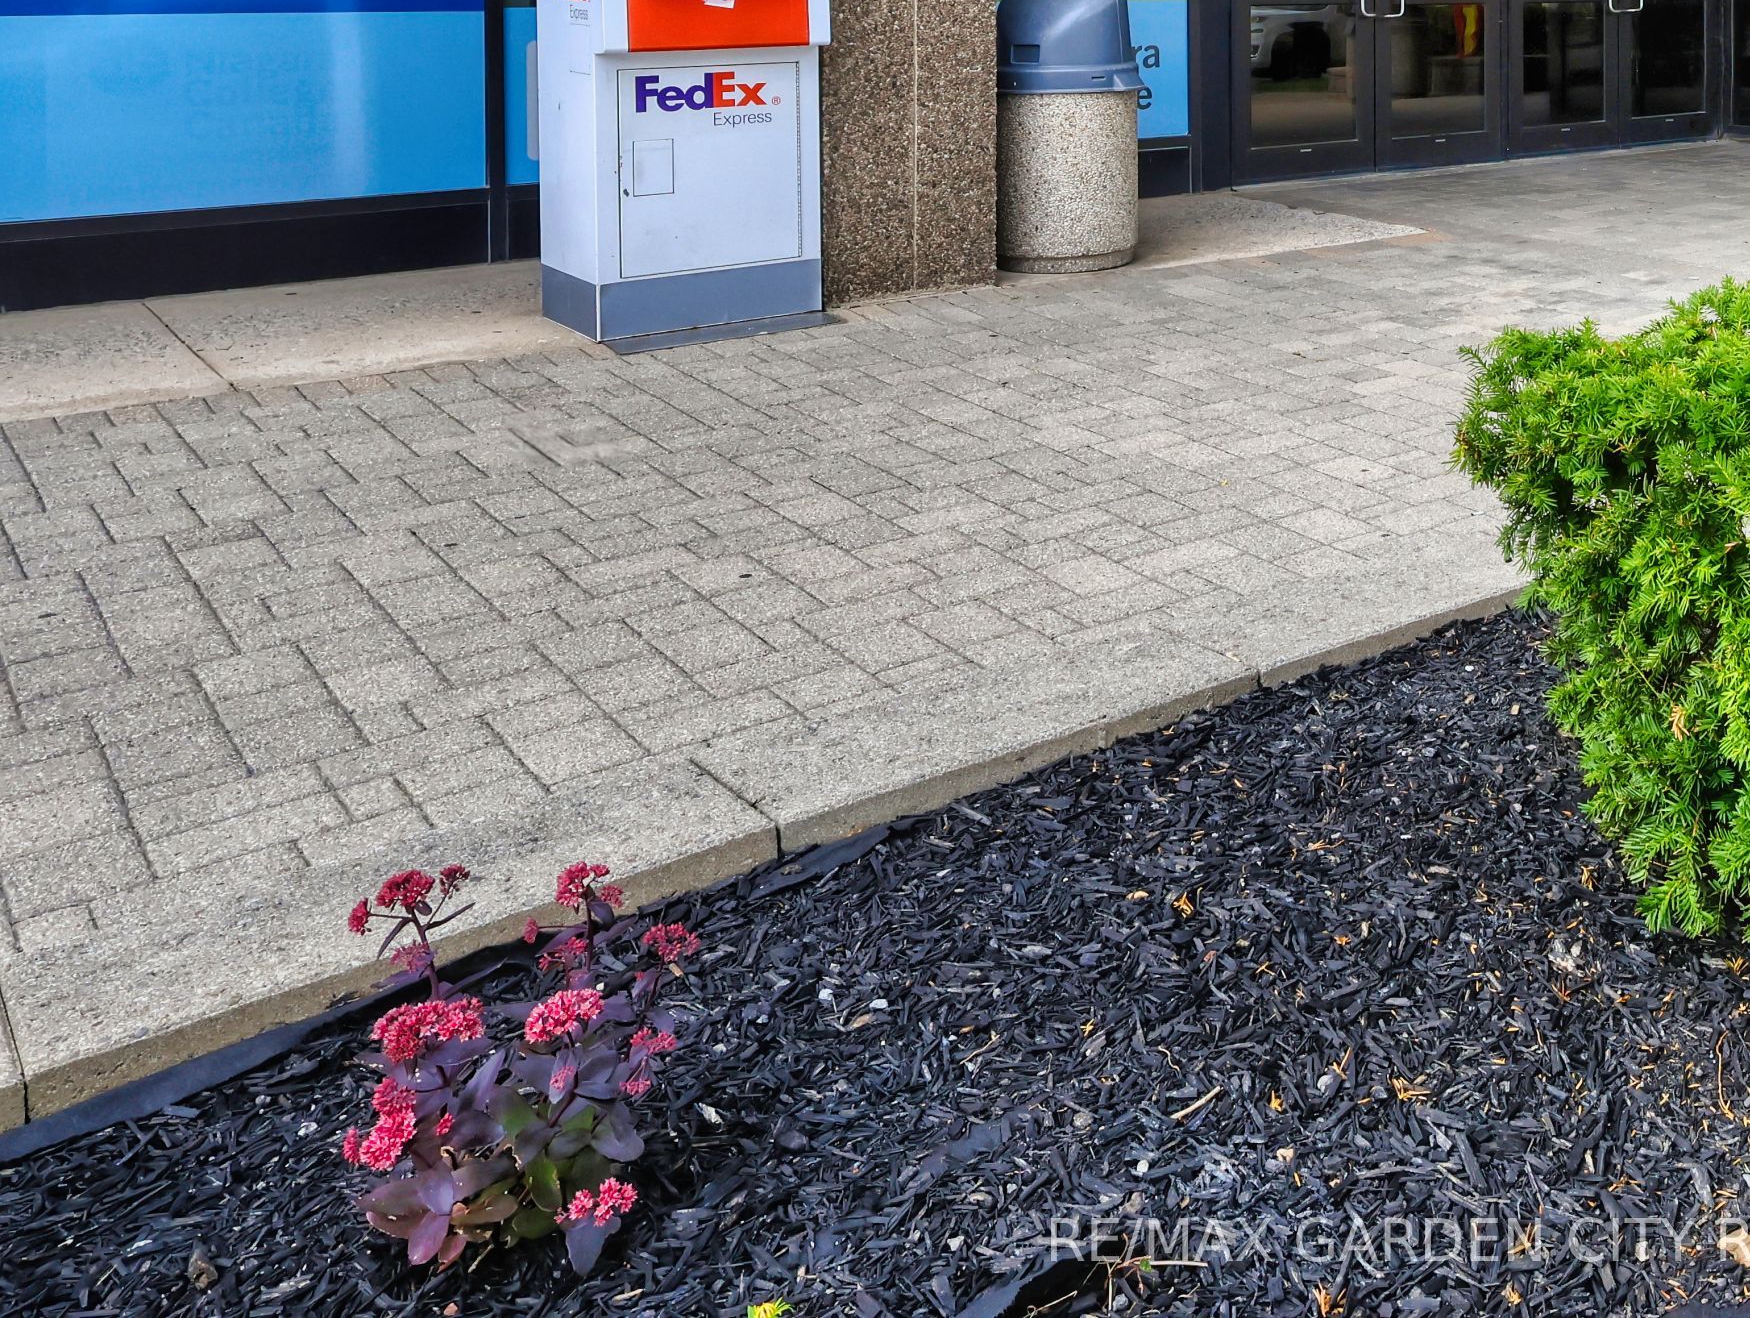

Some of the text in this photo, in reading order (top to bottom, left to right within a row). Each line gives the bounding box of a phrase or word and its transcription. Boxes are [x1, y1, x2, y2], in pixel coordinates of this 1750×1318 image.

[569, 4, 589, 21] Express
[635, 71, 767, 114] FedEx
[713, 112, 773, 127] Express
